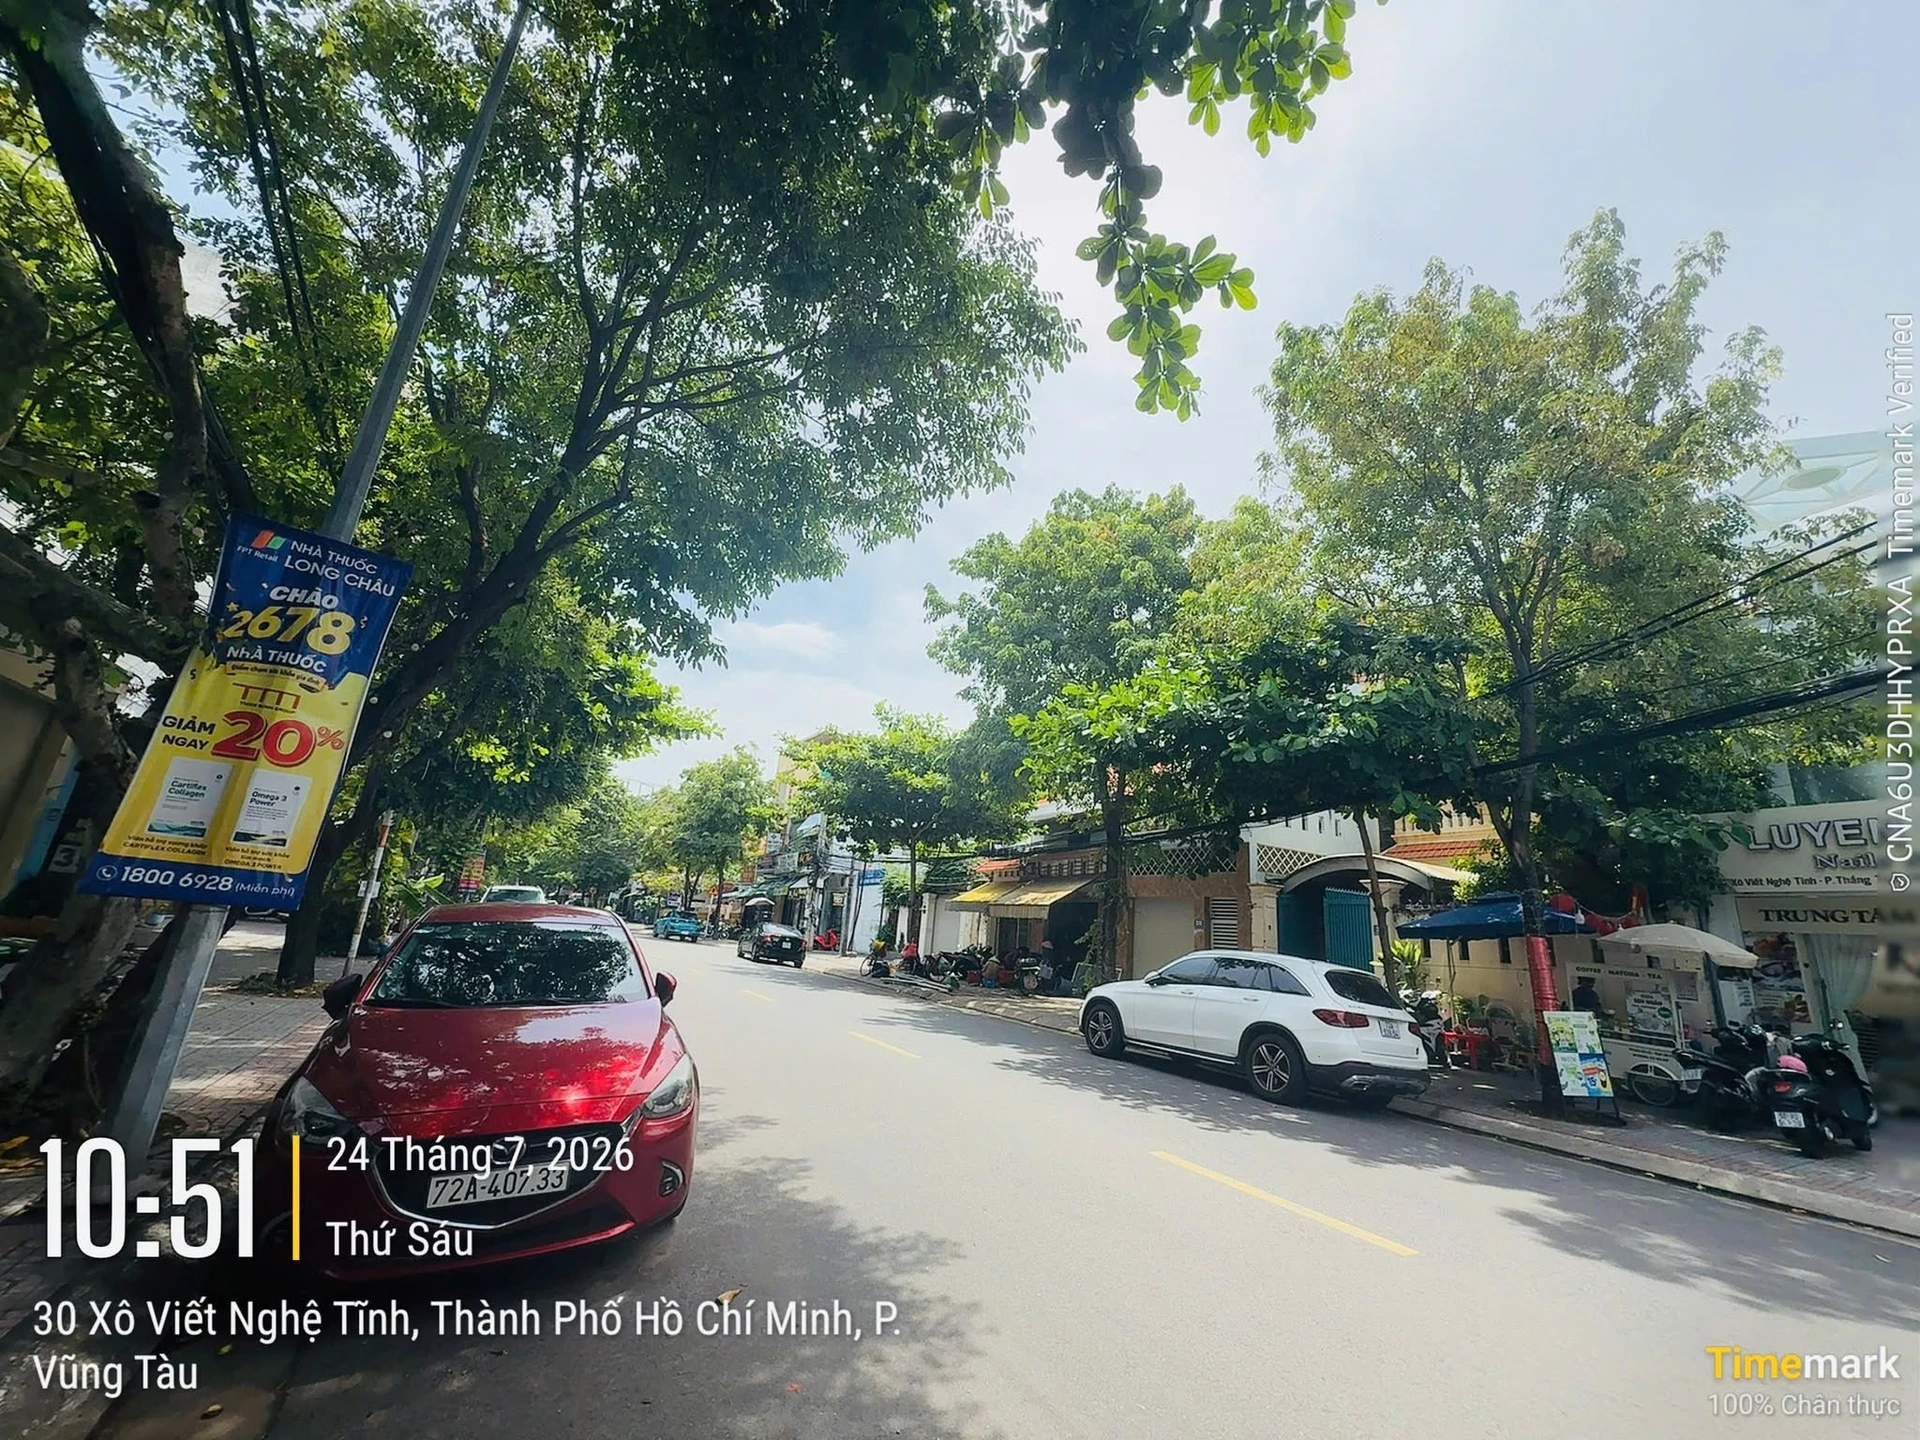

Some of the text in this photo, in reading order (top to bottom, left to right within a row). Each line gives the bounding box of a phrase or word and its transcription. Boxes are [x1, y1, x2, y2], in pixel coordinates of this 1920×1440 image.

[254, 549, 279, 563] Retail
[291, 540, 378, 575] NHÀ THUỐC
[284, 555, 396, 597] LONG CHÂU
[269, 585, 340, 610] CHÀO
[222, 606, 356, 656] 2678
[268, 649, 328, 673] THUỐC
[161, 710, 345, 768] GIẢM 20%
[162, 734, 210, 750] NGAY
[168, 787, 206, 799] Collagen
[250, 798, 276, 807] Power
[252, 790, 280, 802] Omega
[121, 866, 296, 899] 1800 6928 (Miễn phí)
[1758, 908, 1850, 924] TRUNG
[432, 1167, 565, 1205] 72A-407.33
